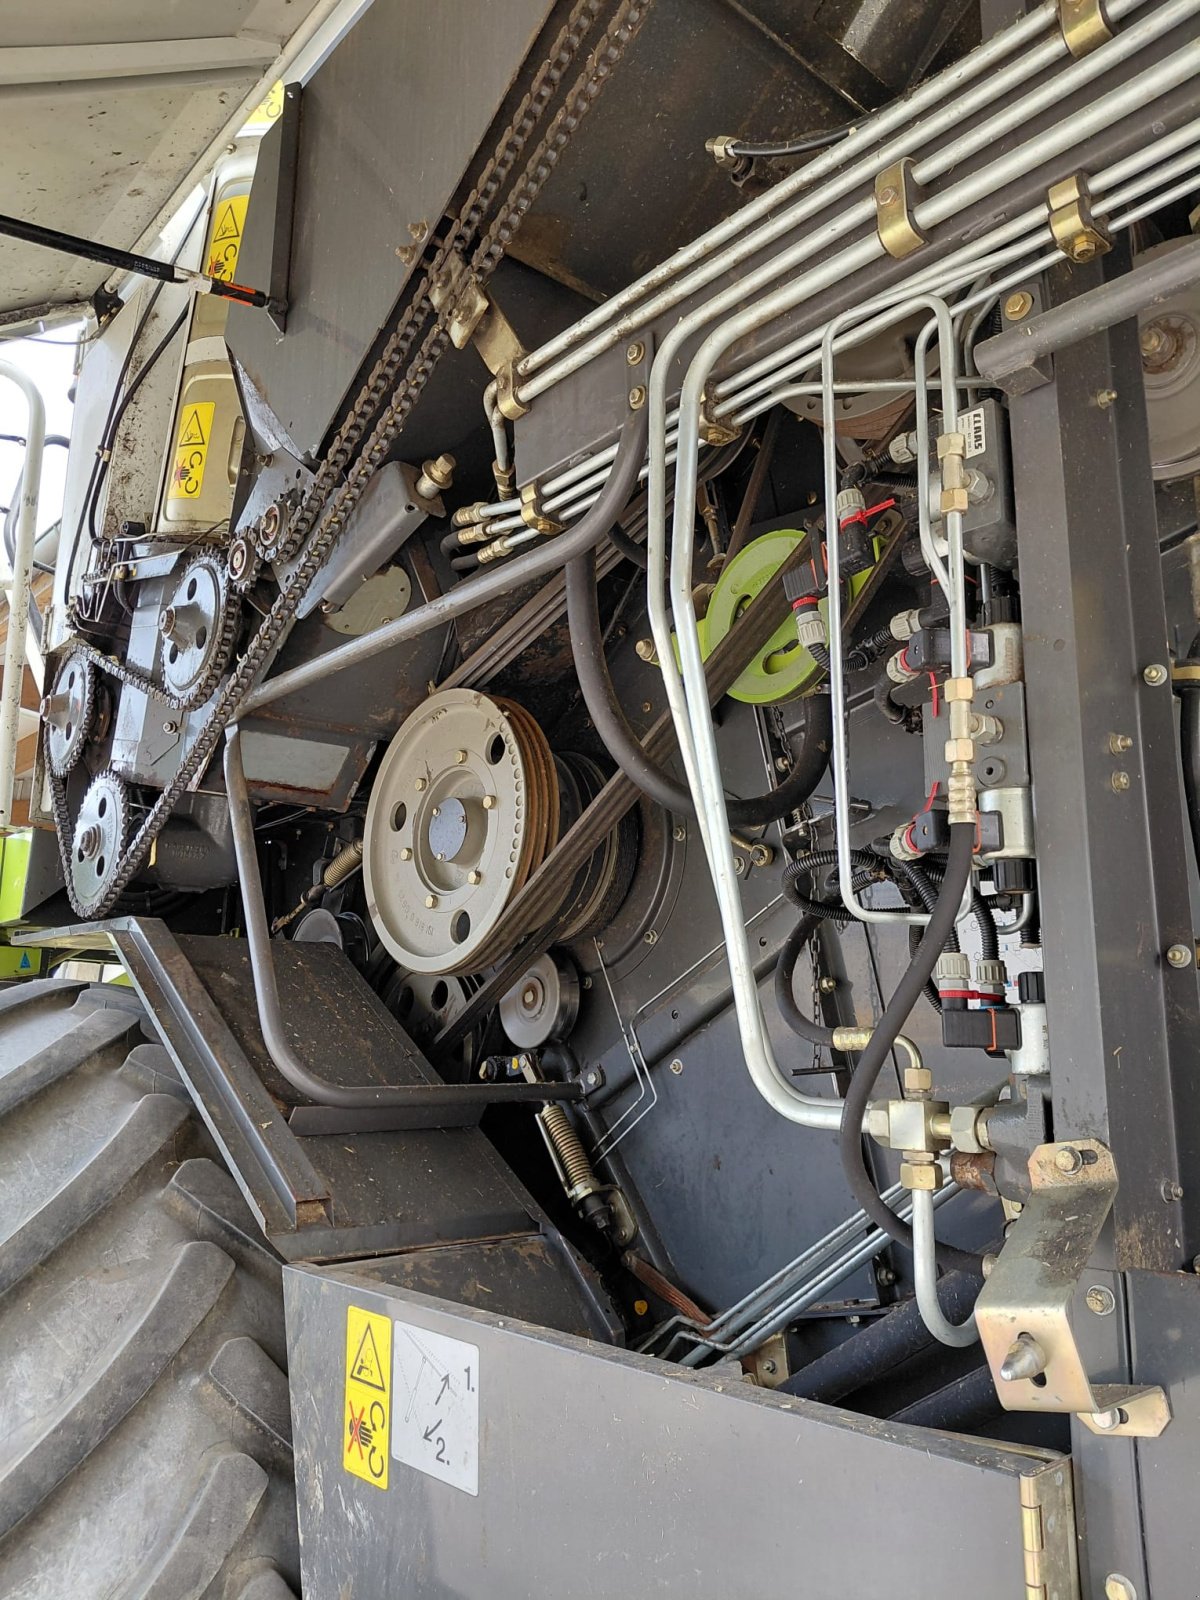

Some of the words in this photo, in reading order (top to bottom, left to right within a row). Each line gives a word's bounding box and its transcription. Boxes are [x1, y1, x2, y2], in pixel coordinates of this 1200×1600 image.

[973, 413, 983, 450] CLAAS
[464, 1366, 475, 1392] 1.
[436, 1436, 450, 1466] 2.
